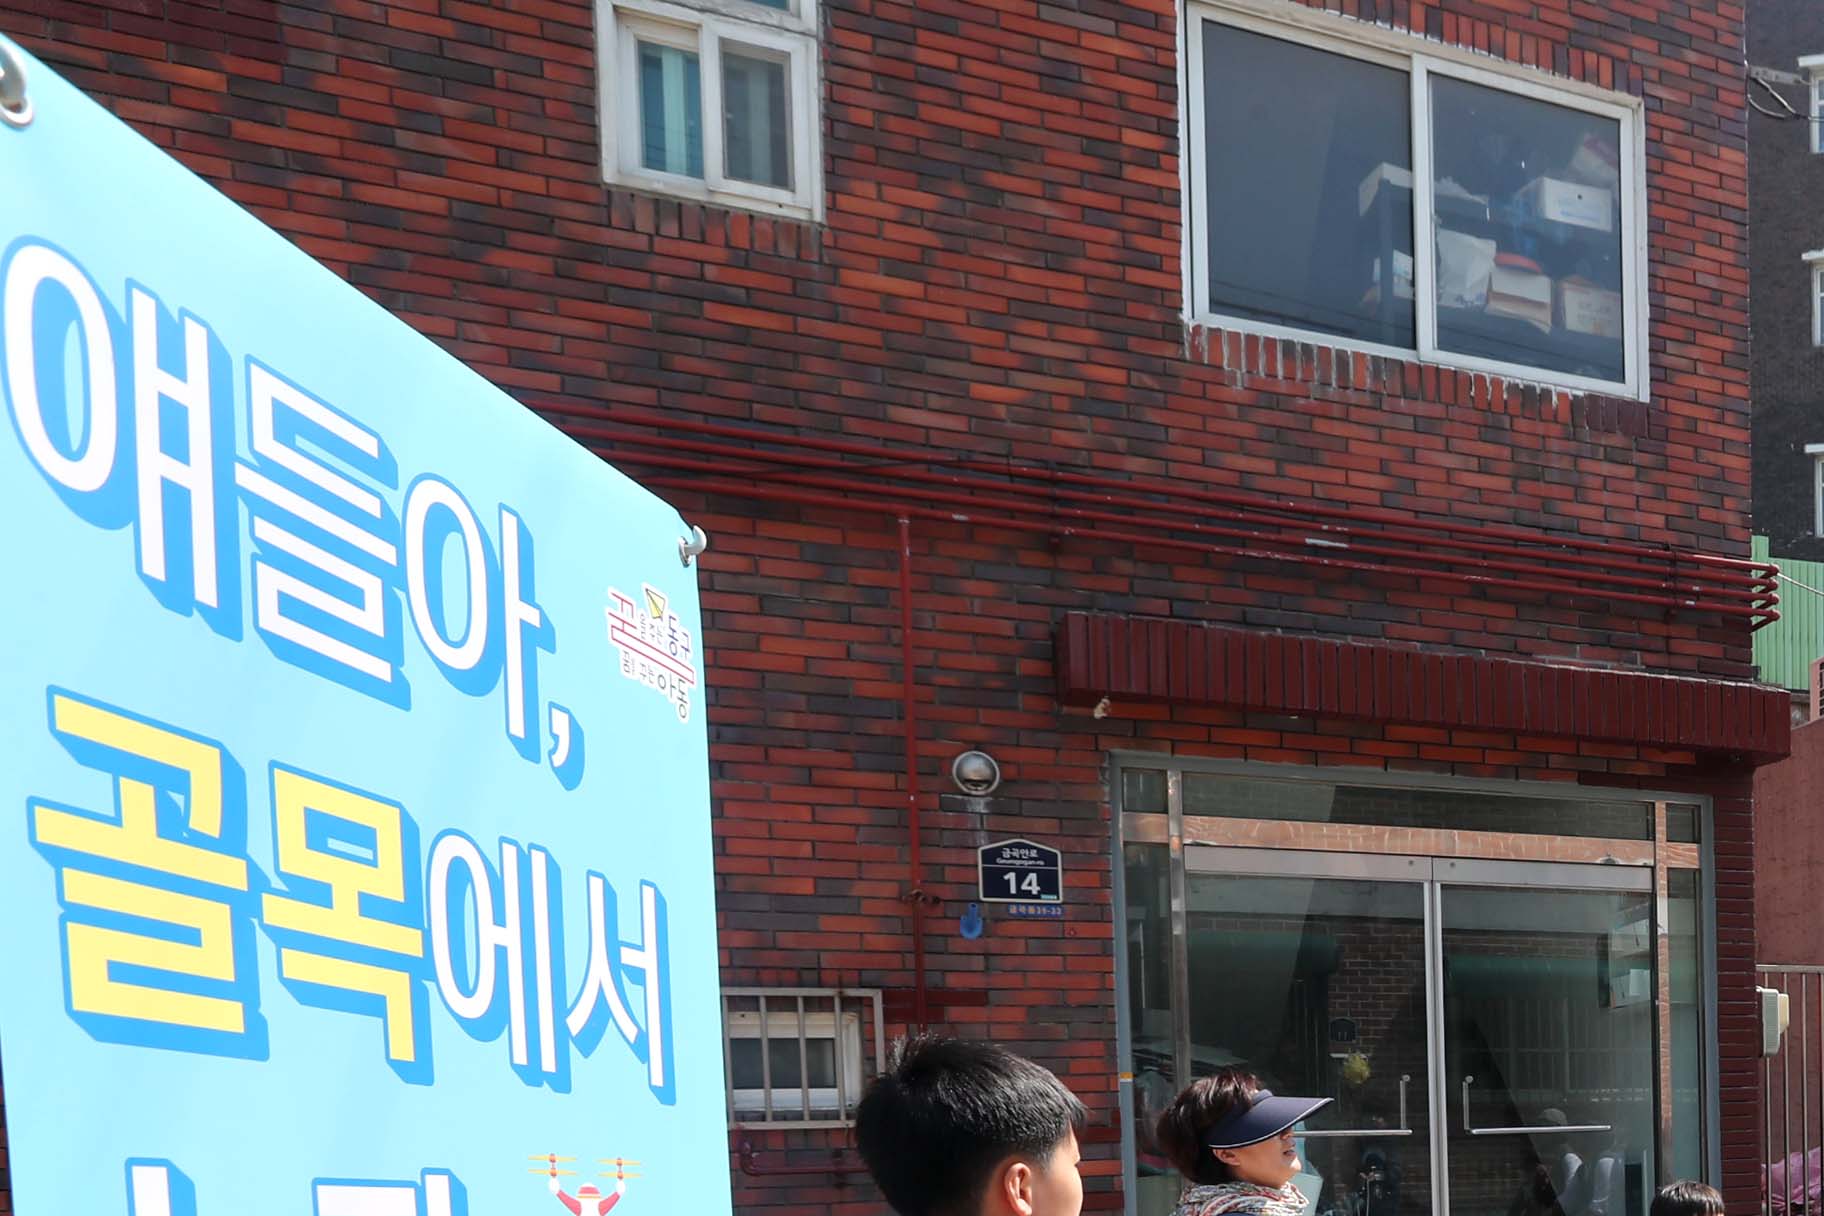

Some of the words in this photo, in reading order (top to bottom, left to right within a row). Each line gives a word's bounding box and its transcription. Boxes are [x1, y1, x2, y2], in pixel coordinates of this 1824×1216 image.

[2, 238, 582, 786] 얘들아,
[656, 672, 689, 719] 아동
[28, 688, 676, 1104] 골목에서
[1003, 871, 1041, 895] 14
